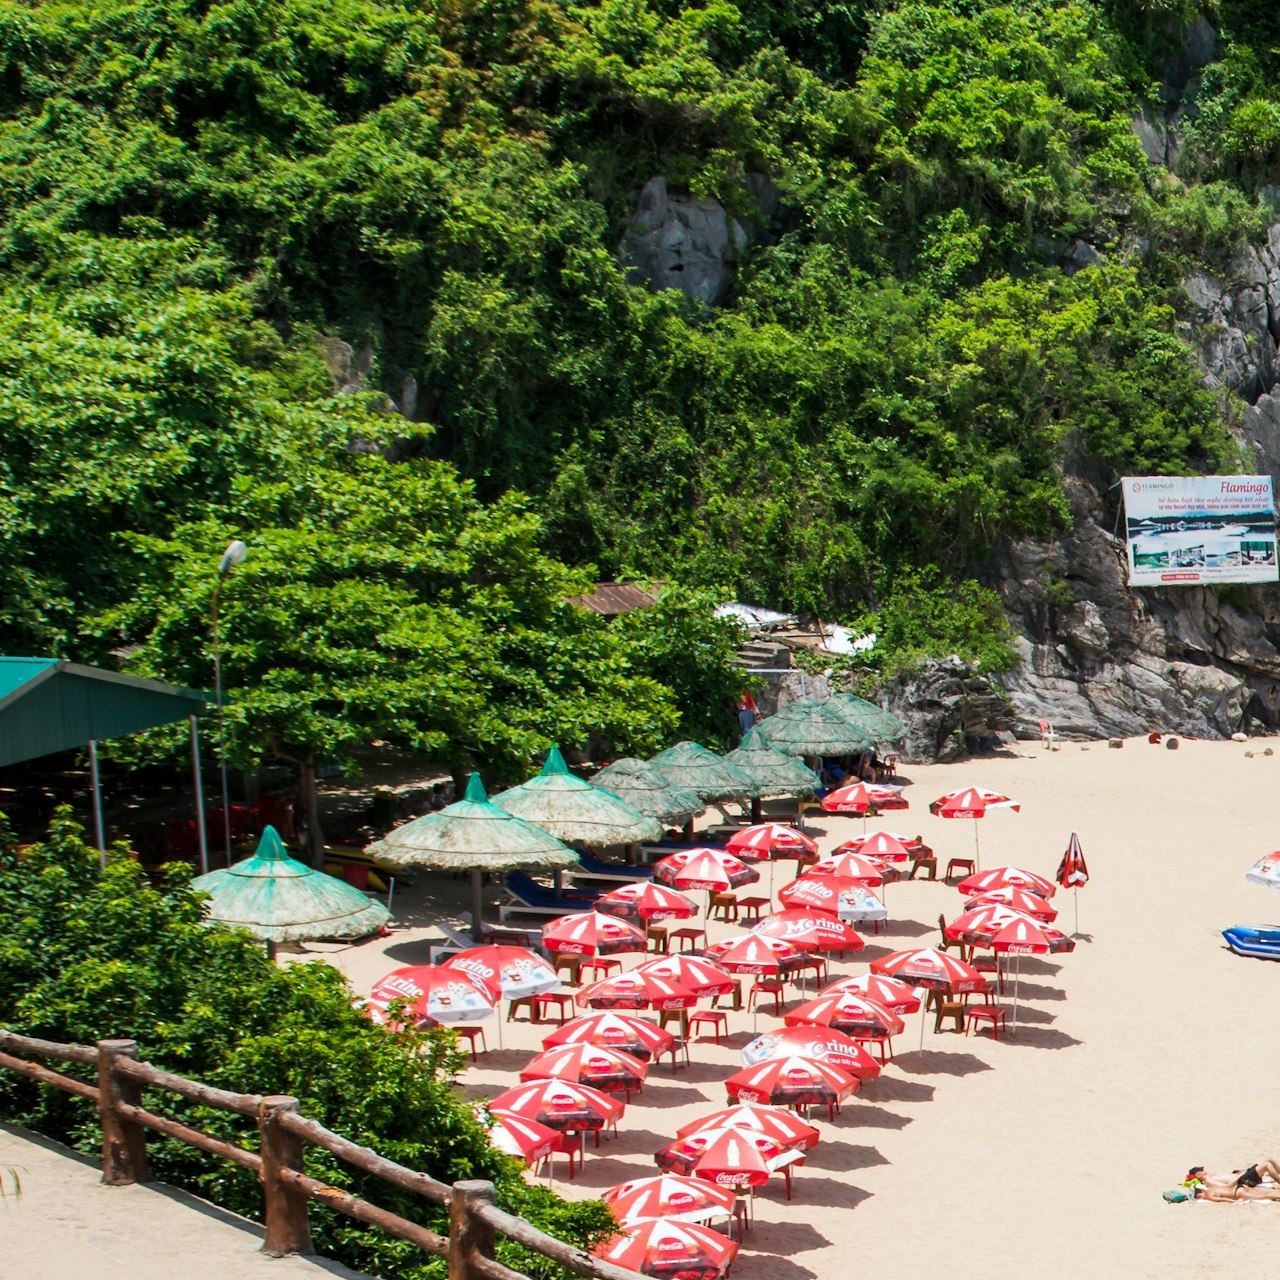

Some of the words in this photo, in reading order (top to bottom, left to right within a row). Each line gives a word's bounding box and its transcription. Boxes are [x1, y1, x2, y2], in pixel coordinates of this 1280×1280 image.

[1220, 481, 1269, 495] Flamingo
[784, 917, 845, 934] Merino
[716, 1172, 752, 1184] Coca-Cola
[669, 1195, 694, 1206] Coca-Cola
[658, 1242, 684, 1251] Coca-Cola
